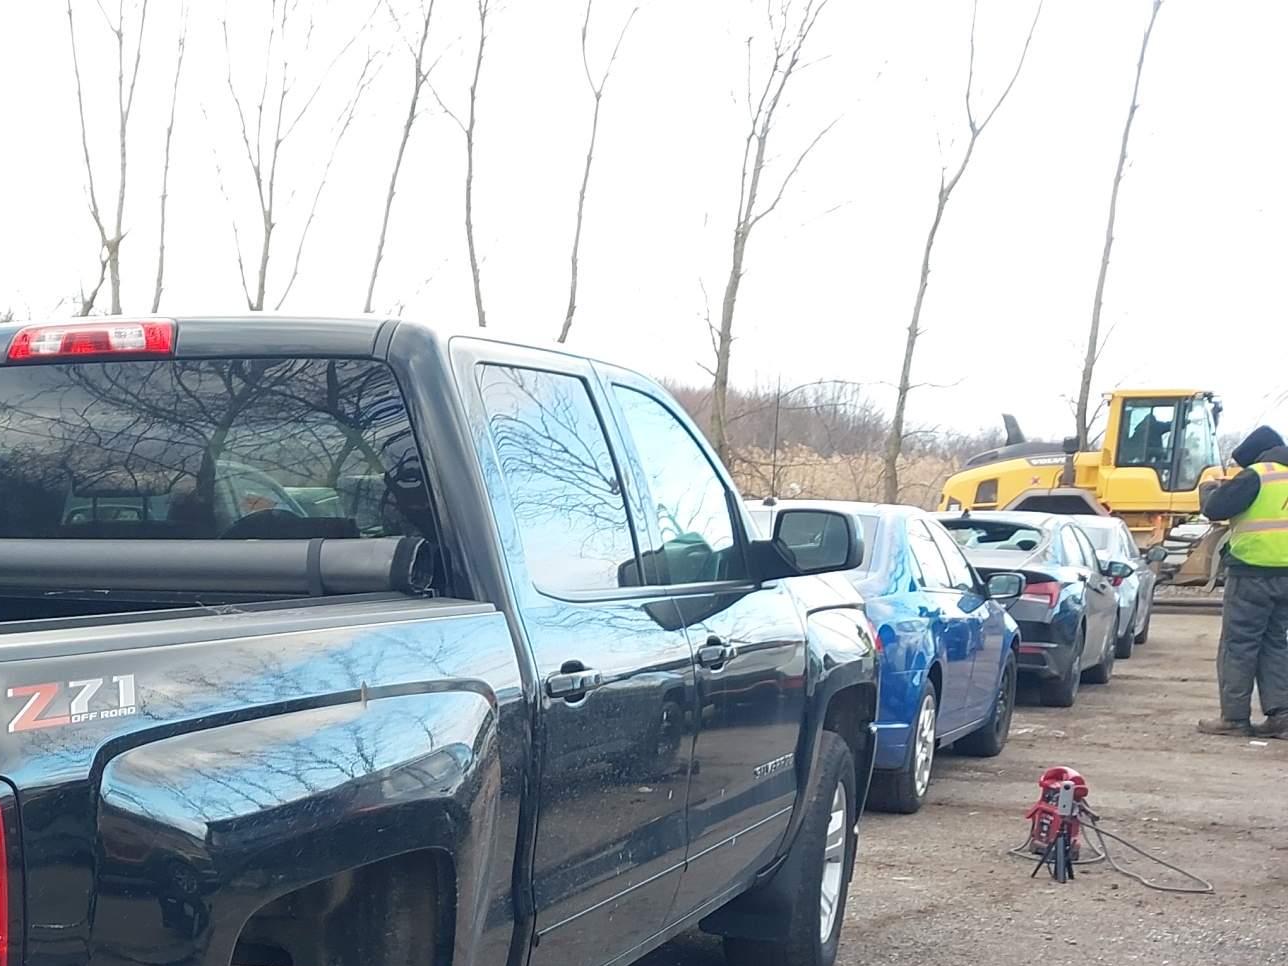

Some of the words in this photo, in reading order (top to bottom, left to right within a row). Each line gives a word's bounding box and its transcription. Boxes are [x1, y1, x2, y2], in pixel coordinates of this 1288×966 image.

[7, 674, 136, 733] Z71
[71, 711, 98, 722] OFF
[100, 706, 136, 719] ROAD
